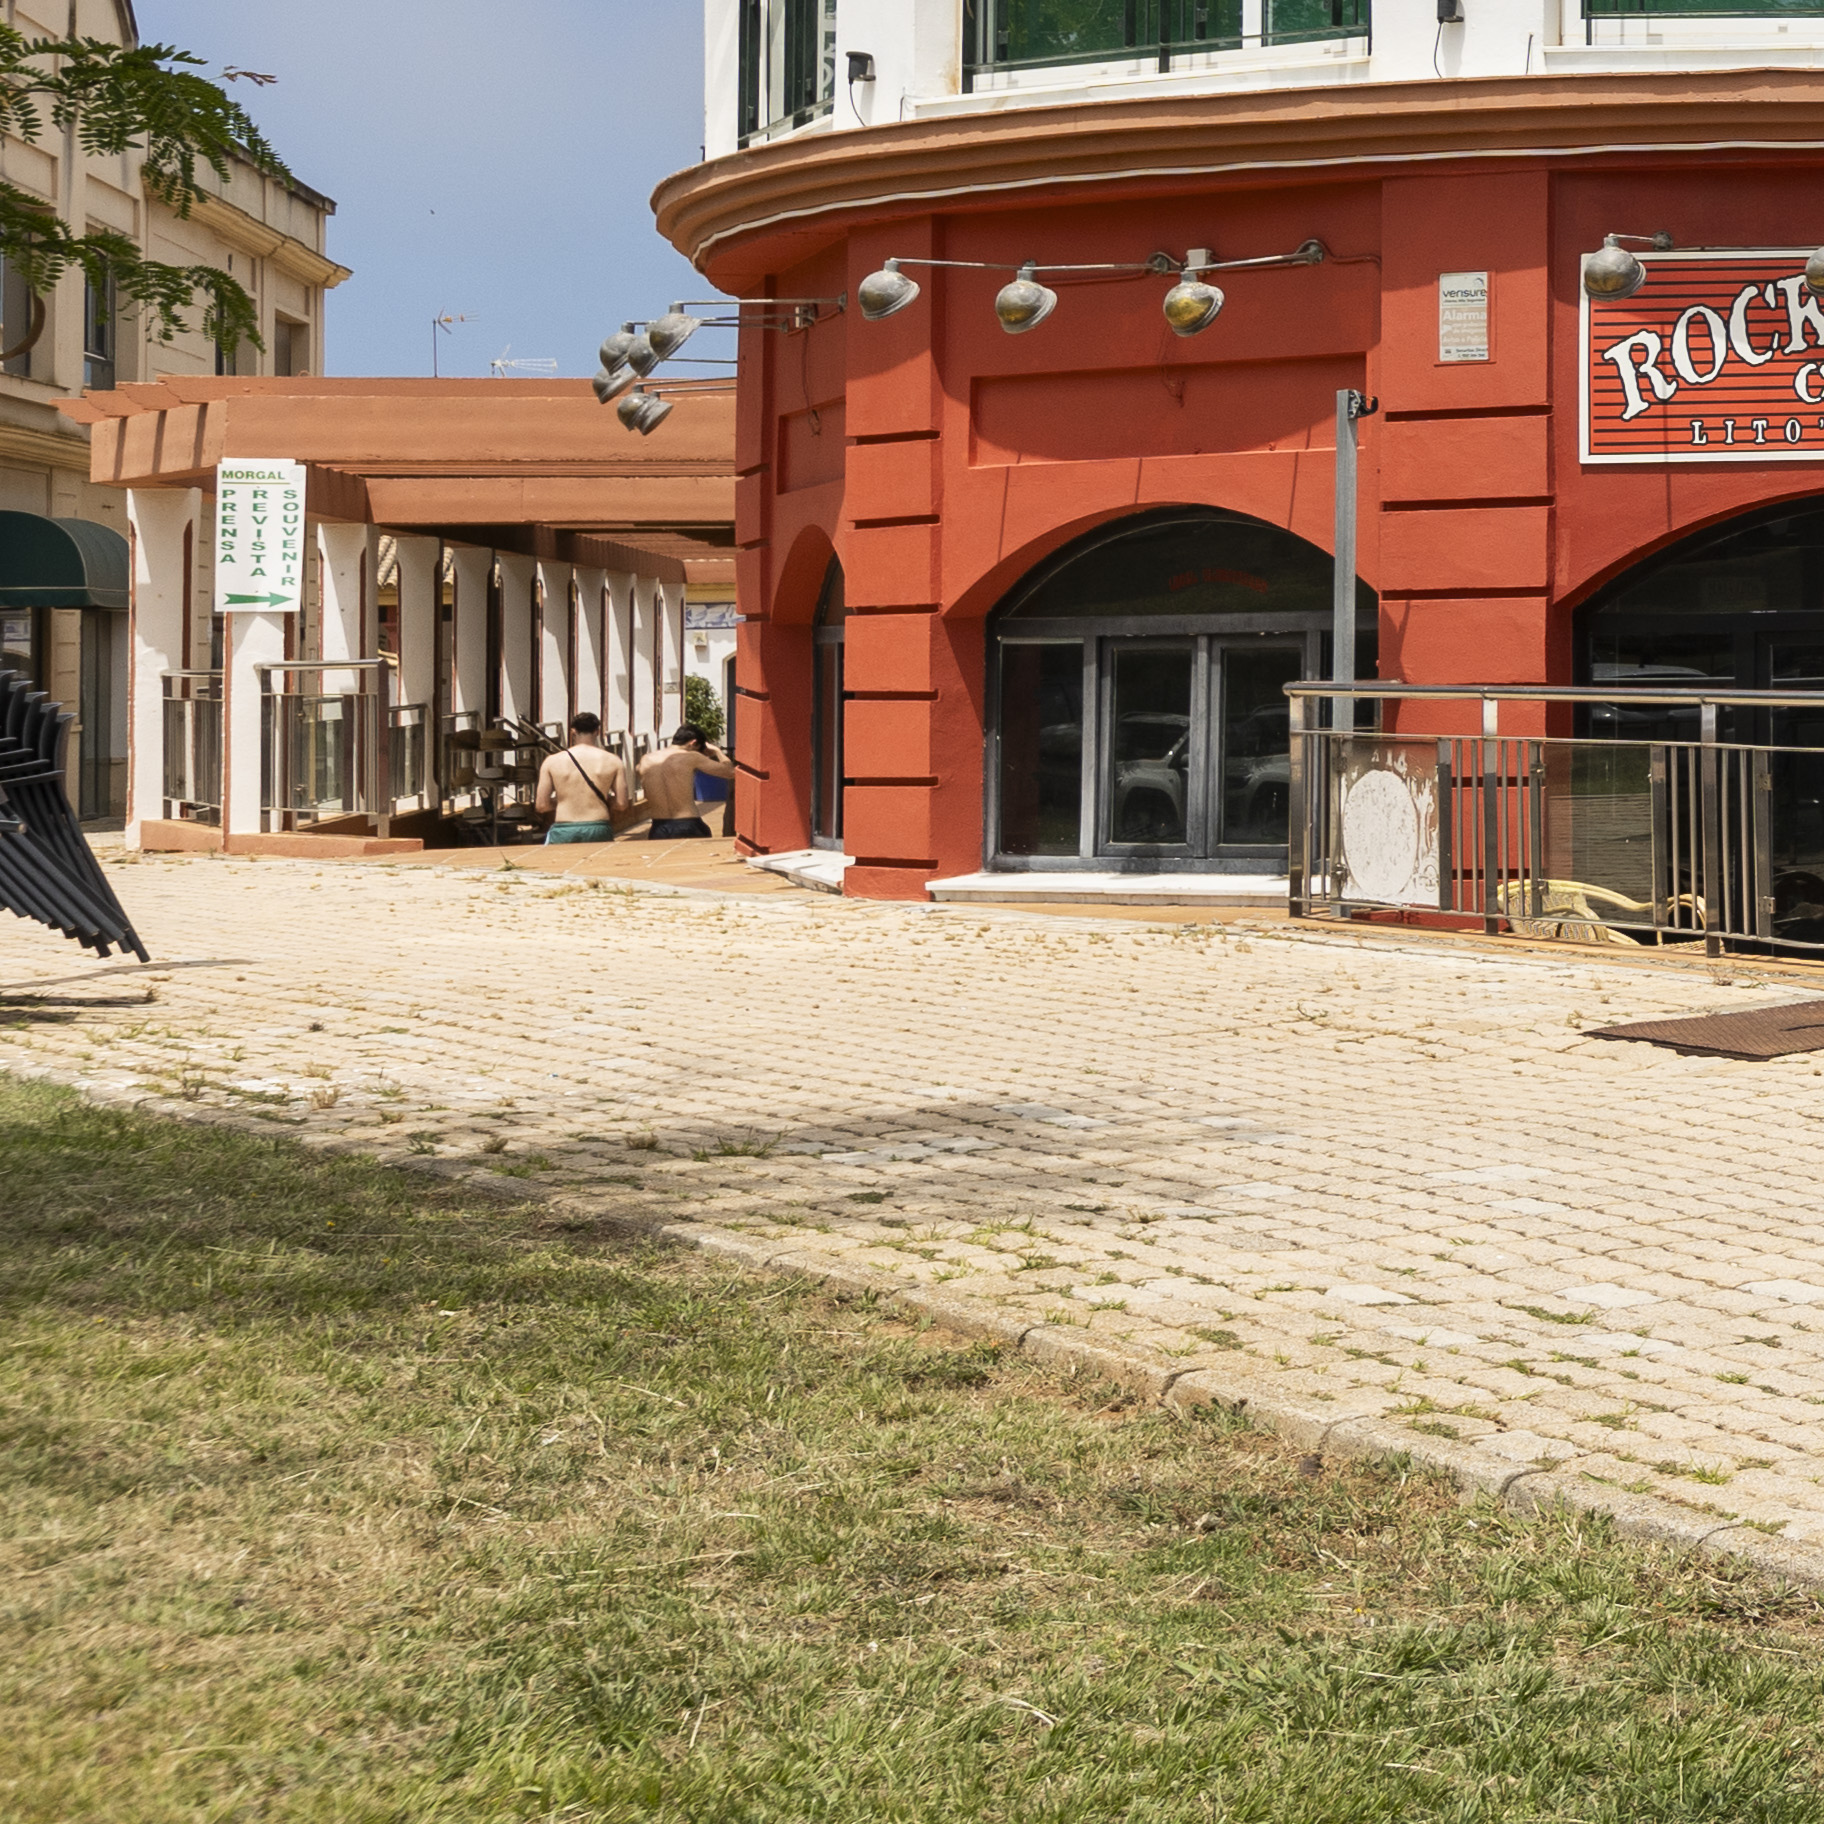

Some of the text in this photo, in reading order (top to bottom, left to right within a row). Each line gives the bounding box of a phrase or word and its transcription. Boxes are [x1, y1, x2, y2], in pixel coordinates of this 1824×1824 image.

[221, 470, 286, 480] MORGAL
[220, 489, 238, 564] PRENSA
[250, 490, 269, 577] REVISTA
[281, 489, 300, 587] SOUVENIR
